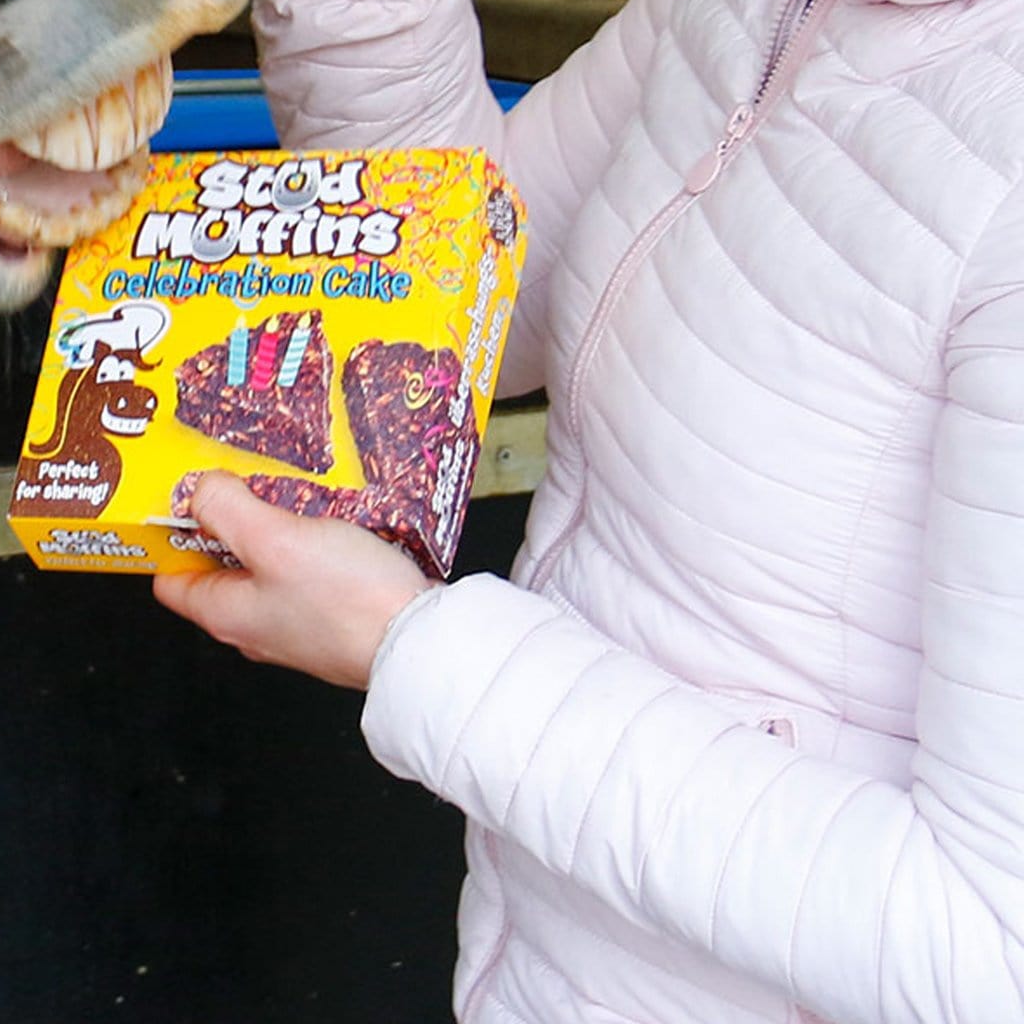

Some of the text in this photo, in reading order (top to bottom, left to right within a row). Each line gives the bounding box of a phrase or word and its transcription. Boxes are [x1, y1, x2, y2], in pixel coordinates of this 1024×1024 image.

[197, 159, 366, 211] Stud
[133, 205, 402, 263] Muffins
[103, 258, 412, 303] Celebration Cake
[16, 480, 109, 506] for sharing!
[38, 460, 99, 481] Perfect
